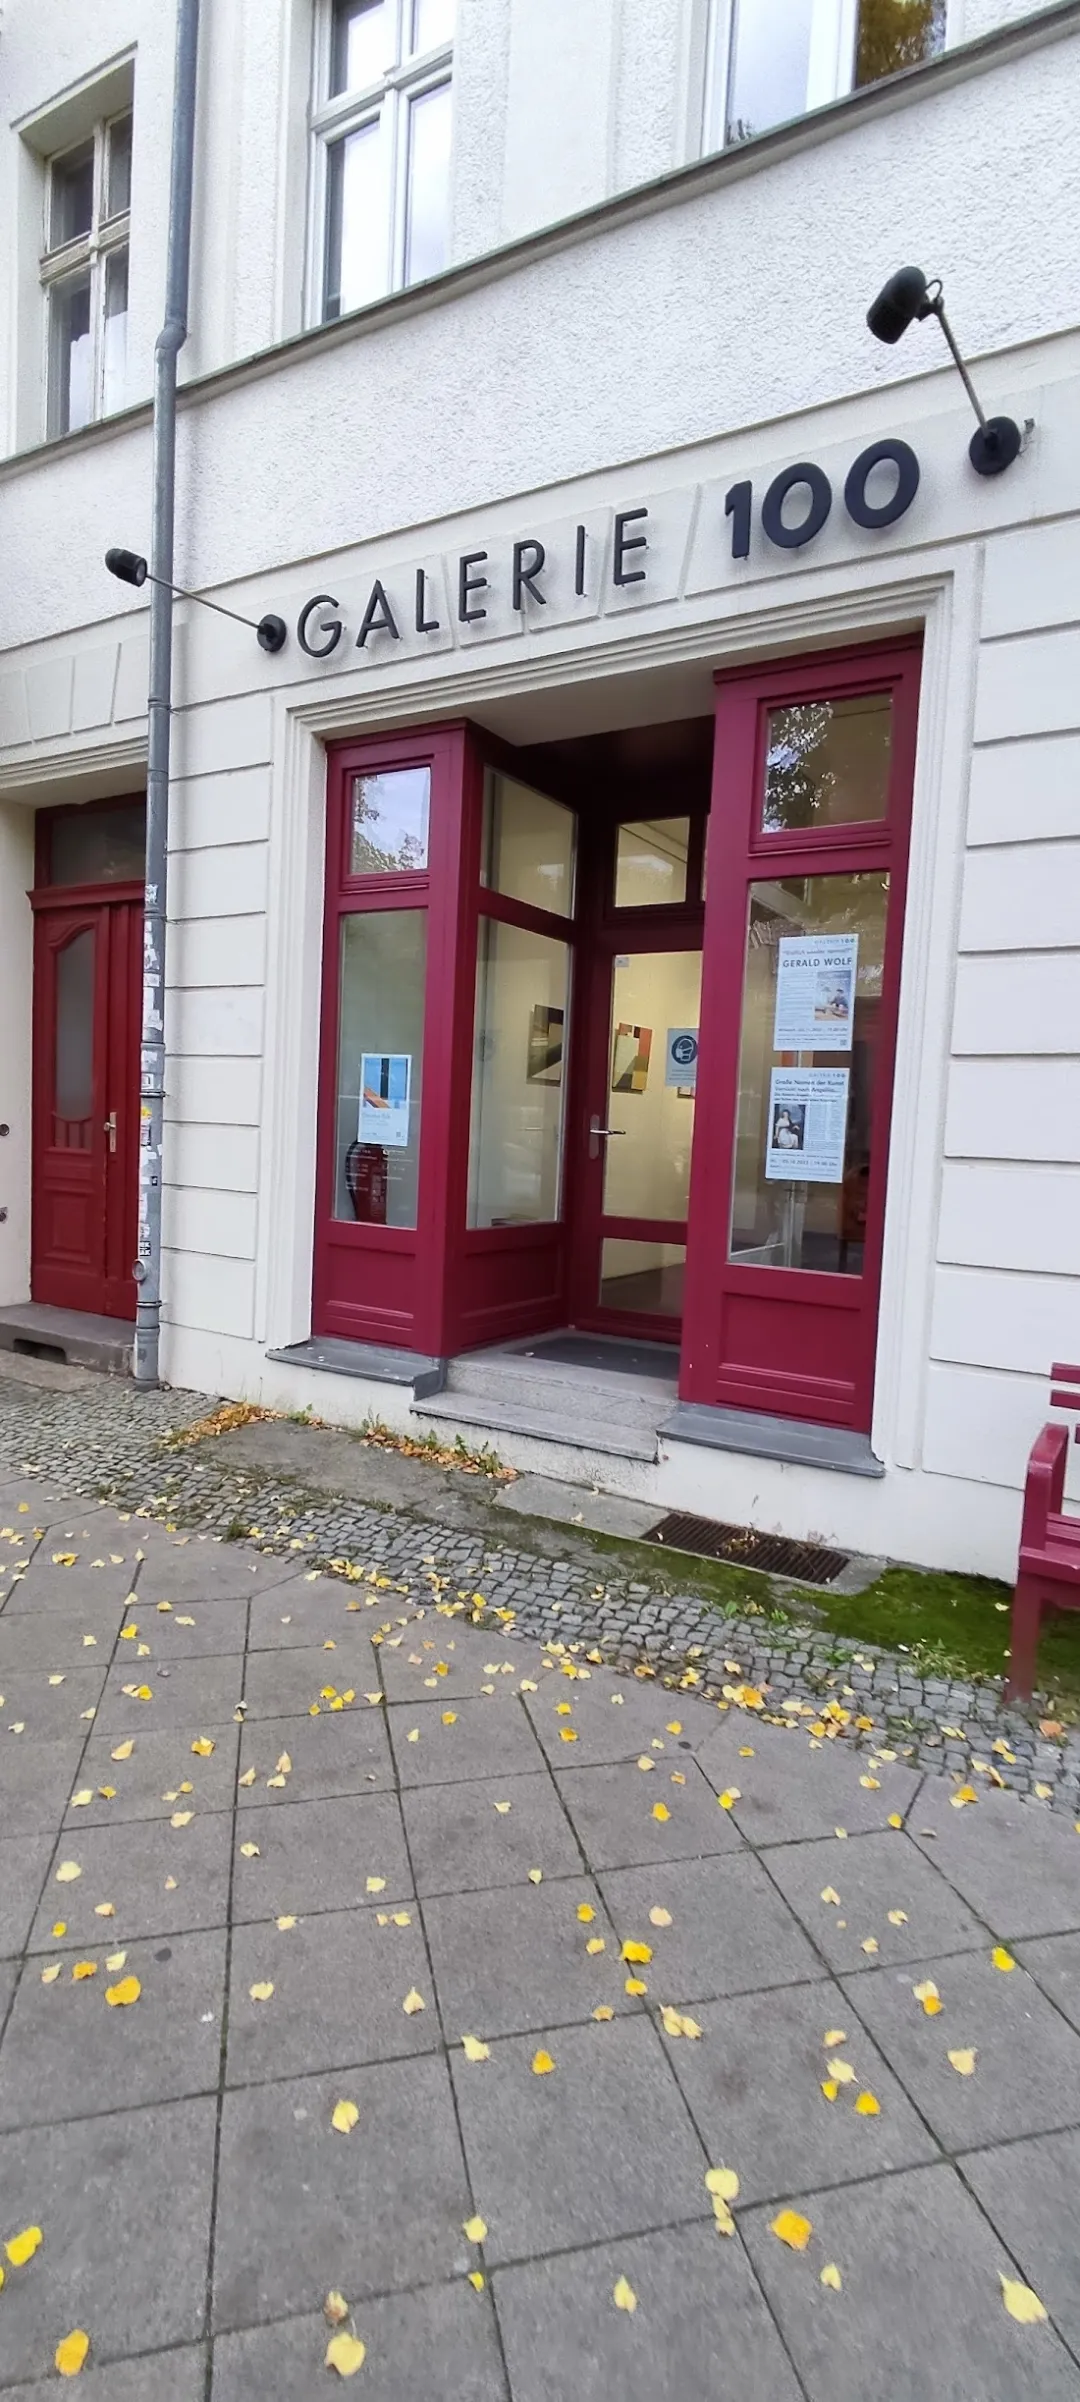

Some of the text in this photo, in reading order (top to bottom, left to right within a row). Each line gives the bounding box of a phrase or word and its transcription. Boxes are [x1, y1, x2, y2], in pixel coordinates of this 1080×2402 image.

[297, 438, 920, 659] GALERIE 100
[782, 957, 853, 968] GERALD WOLF
